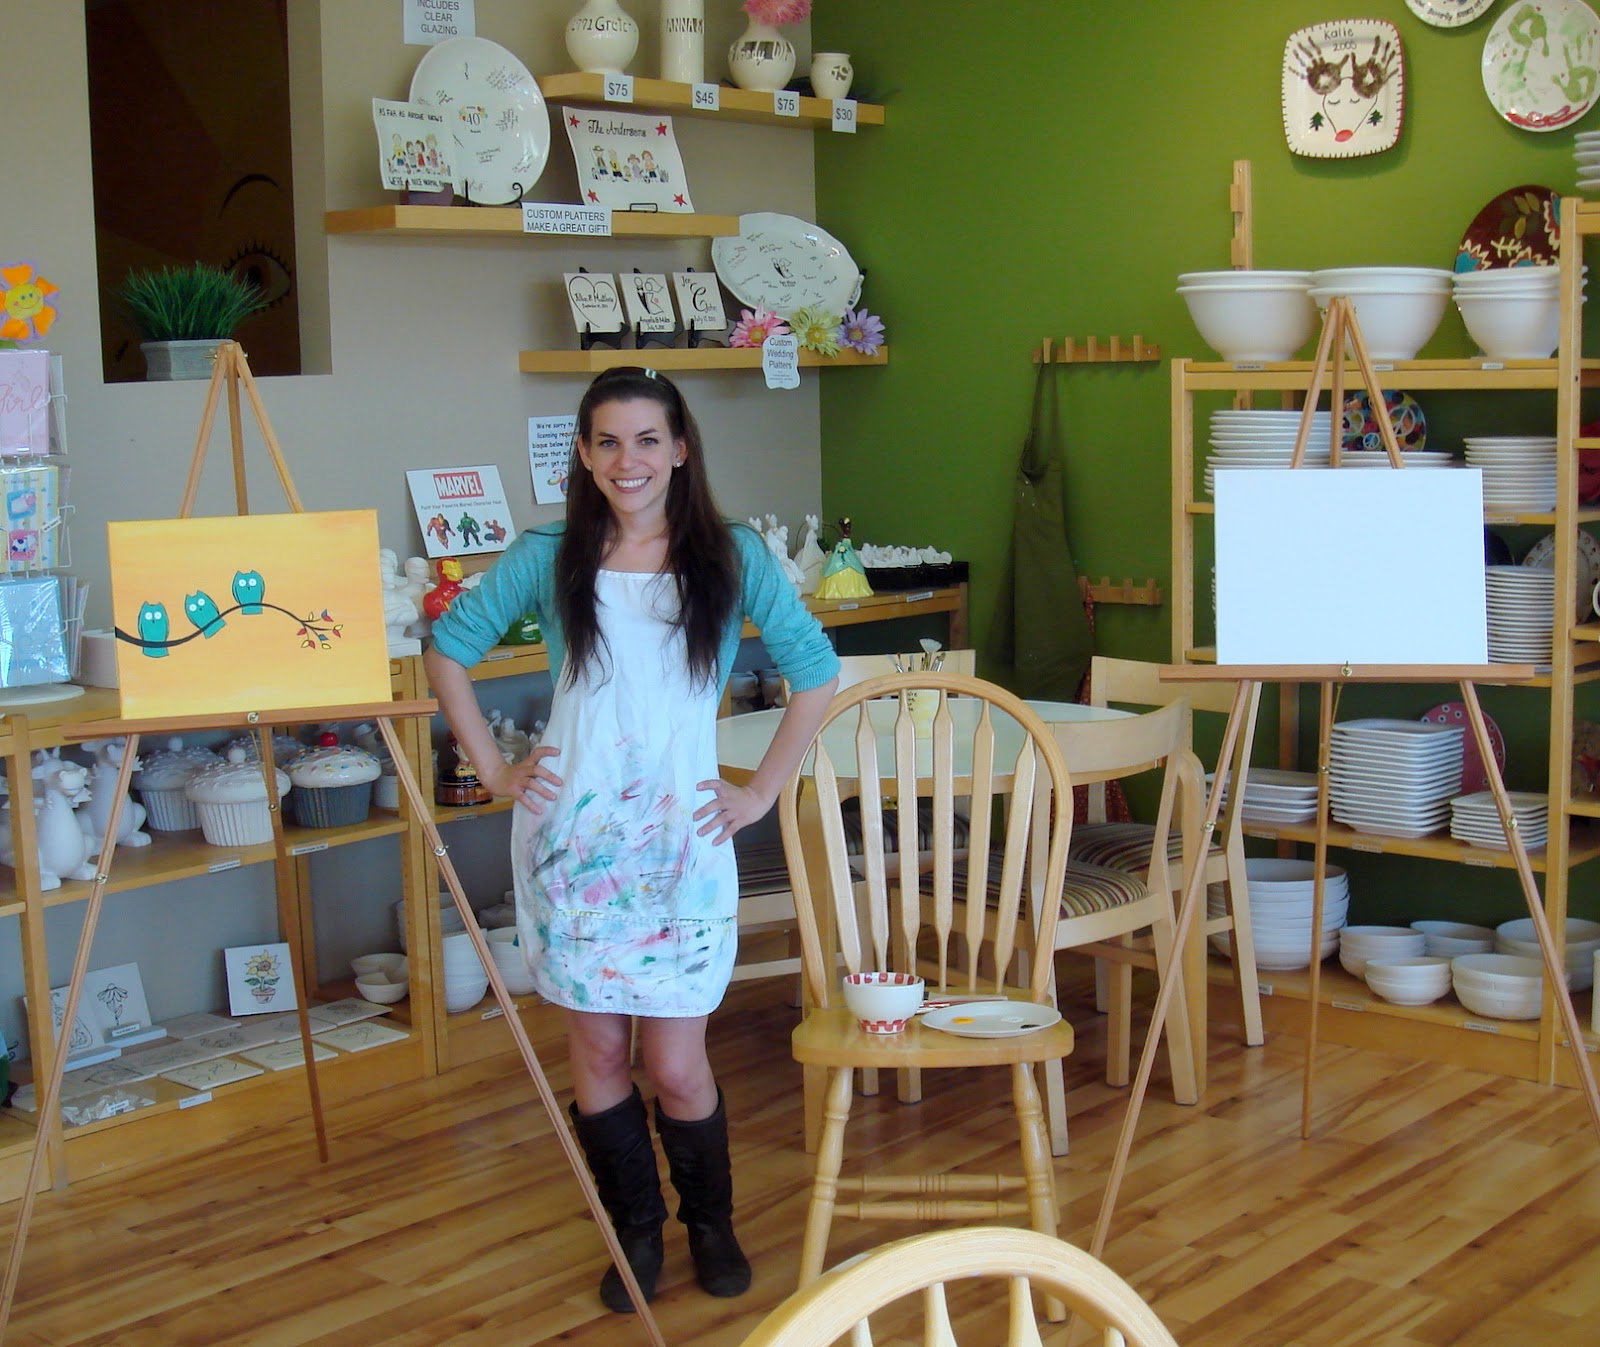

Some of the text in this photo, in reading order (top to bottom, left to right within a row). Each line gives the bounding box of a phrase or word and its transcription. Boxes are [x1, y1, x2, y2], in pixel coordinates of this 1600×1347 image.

[417, 0, 460, 11] INCLUDES
[424, 11, 453, 22] CLEAR
[421, 23, 458, 35] GLAZING
[608, 82, 628, 97] $75
[695, 90, 714, 105] $45
[777, 97, 795, 111] $75
[835, 107, 853, 121] $30
[588, 119, 647, 138] The Andersons
[526, 209, 605, 221] CUSTOM PLATTERS
[526, 222, 609, 234] MAKE A GREAT GIFT!
[770, 337, 792, 346] Custom
[767, 349, 793, 360] Wedding
[768, 360, 792, 369] Platters
[553, 422, 566, 430] sorry
[537, 432, 557, 440] licensing
[532, 442, 548, 450] bisque
[533, 451, 549, 459] Bisque
[434, 473, 484, 498] MARVEL
